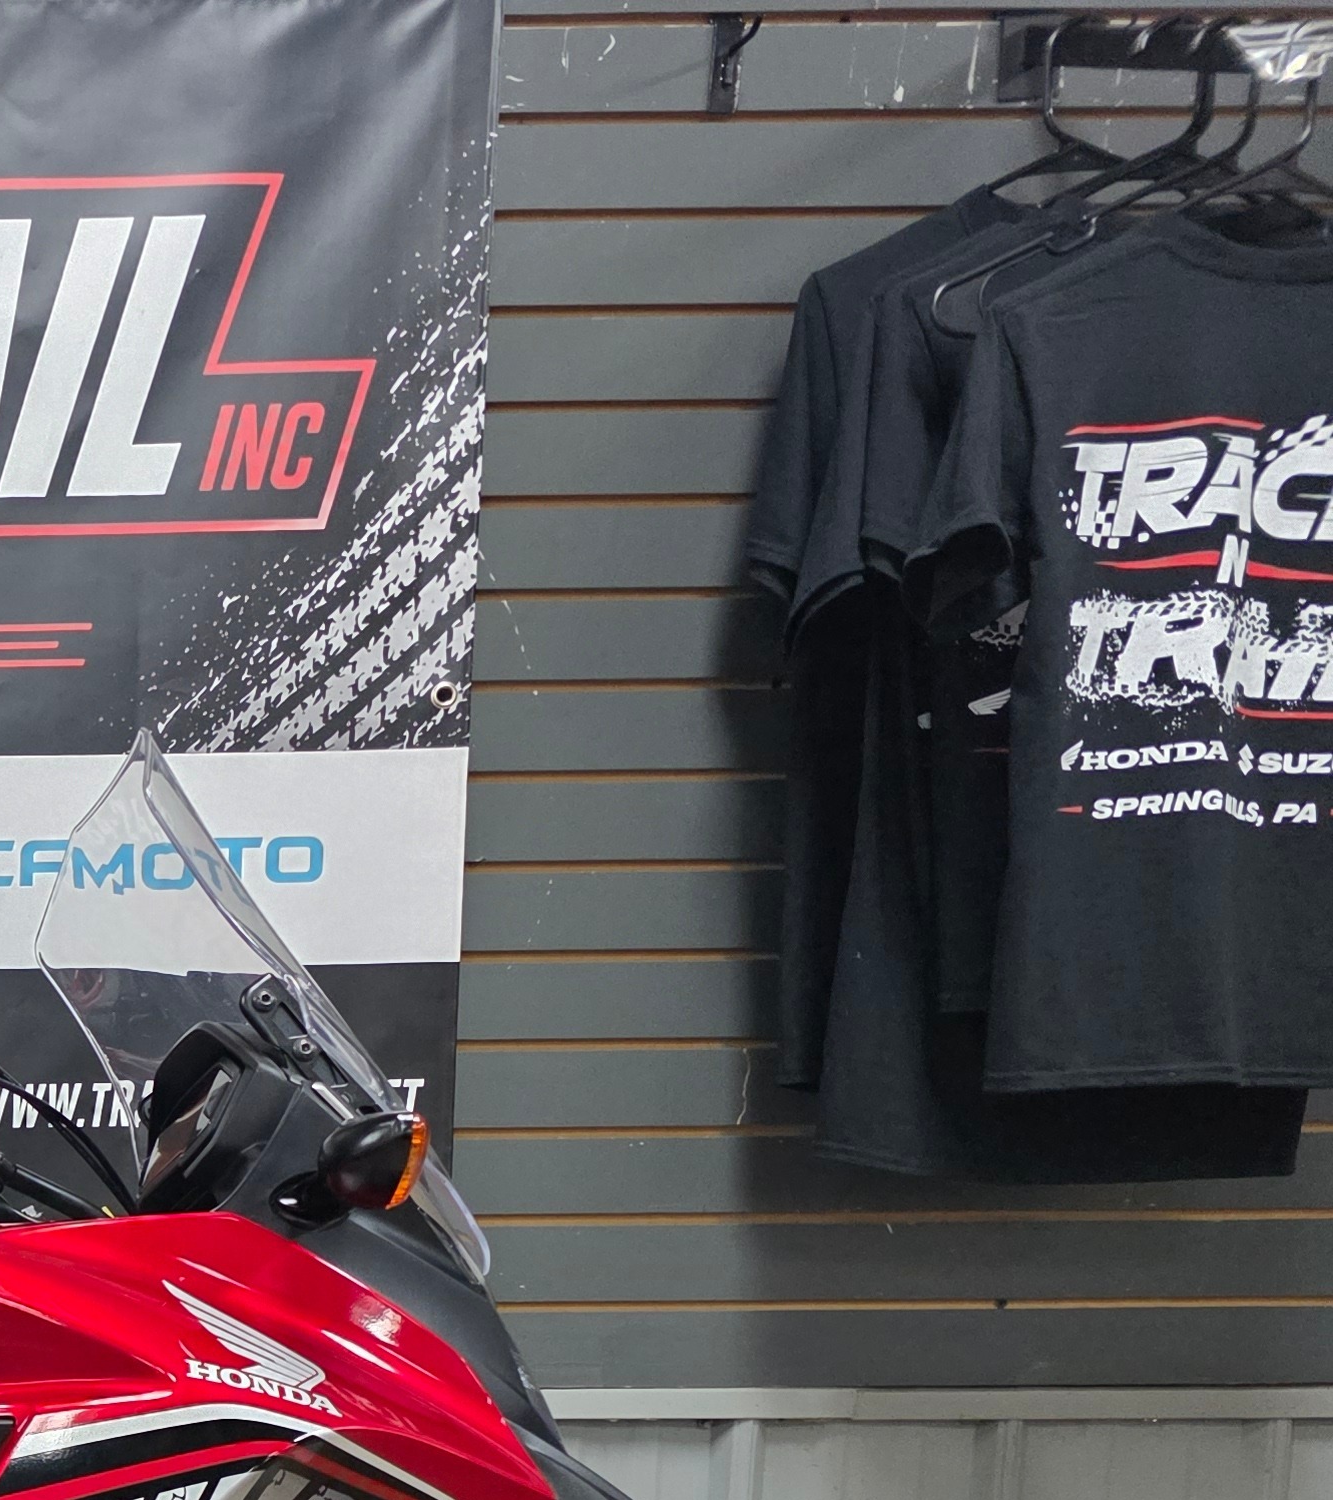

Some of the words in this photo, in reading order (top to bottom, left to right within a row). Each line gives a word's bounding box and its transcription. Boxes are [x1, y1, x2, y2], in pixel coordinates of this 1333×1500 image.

[199, 400, 325, 492] INC
[1061, 432, 1333, 542] TRAC
[1216, 534, 1249, 588] N
[1080, 741, 1229, 771] HONDA
[1258, 752, 1333, 774] SUZ
[1092, 789, 1224, 819] SPRING
[1272, 803, 1317, 824] PA
[184, 1358, 343, 1418] HONDA
